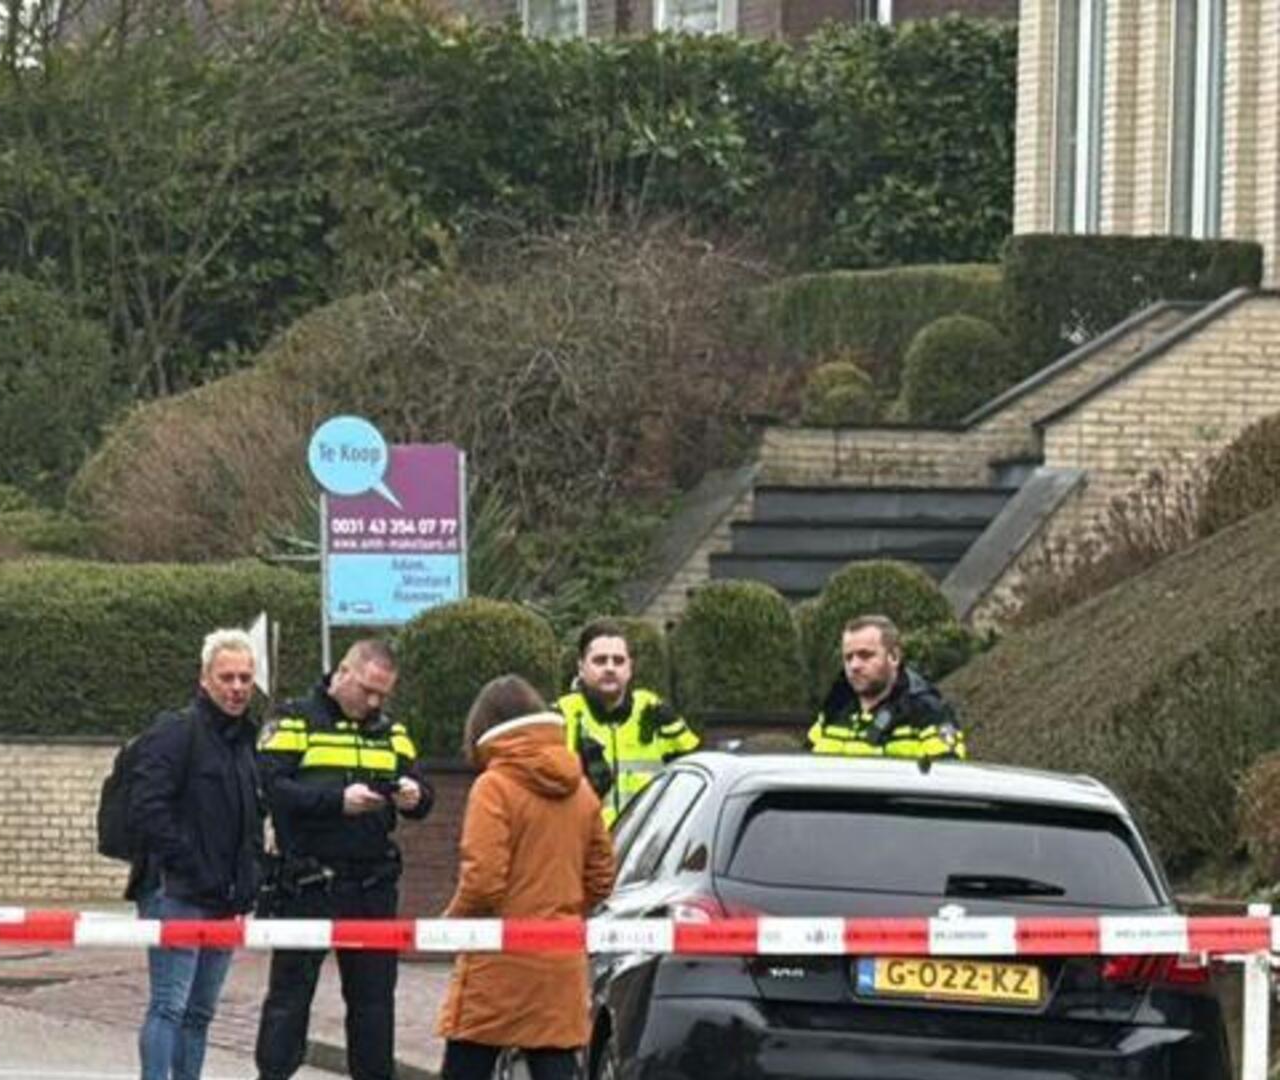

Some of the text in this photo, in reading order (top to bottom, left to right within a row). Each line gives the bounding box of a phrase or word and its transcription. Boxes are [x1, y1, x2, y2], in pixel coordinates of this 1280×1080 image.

[341, 445, 382, 468] Koop
[330, 518, 364, 535] 0031
[440, 518, 458, 535] 77
[886, 958, 1032, 995] G-022-KZ
